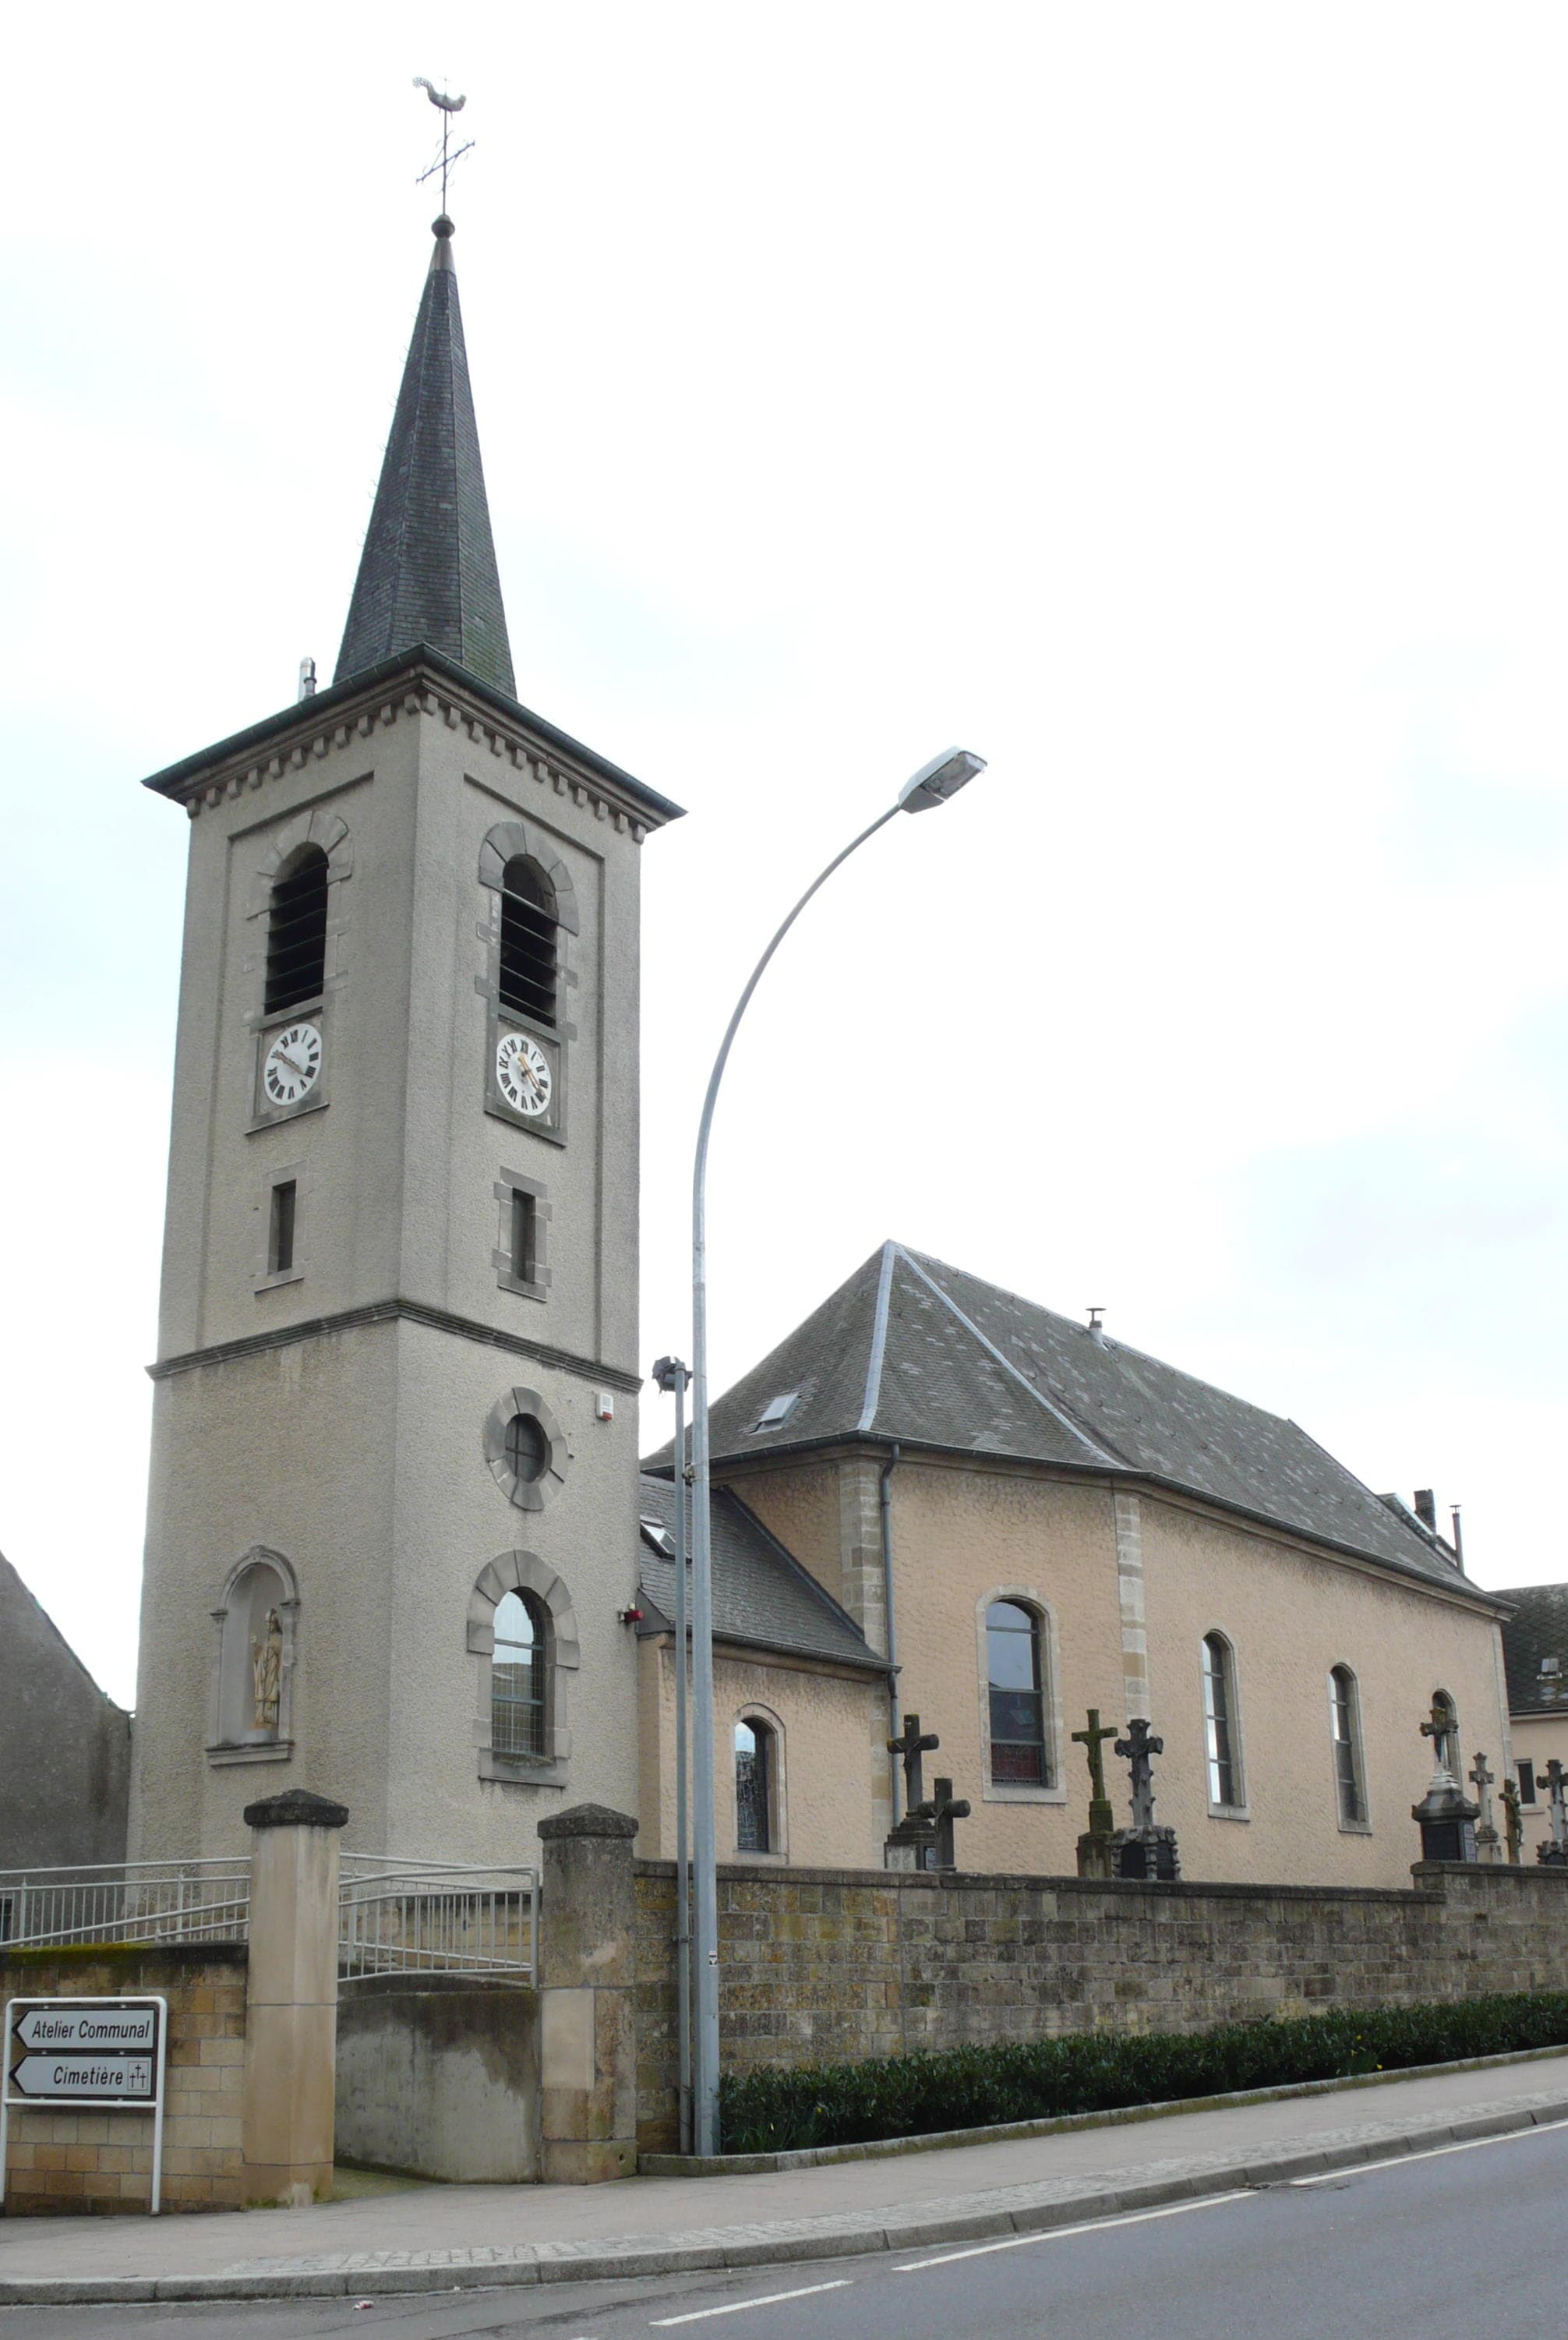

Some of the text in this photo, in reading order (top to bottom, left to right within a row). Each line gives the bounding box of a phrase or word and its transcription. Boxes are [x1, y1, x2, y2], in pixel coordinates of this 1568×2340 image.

[31, 2020, 150, 2039] Atelier Communal
[53, 2066, 124, 2085] Cimetière
